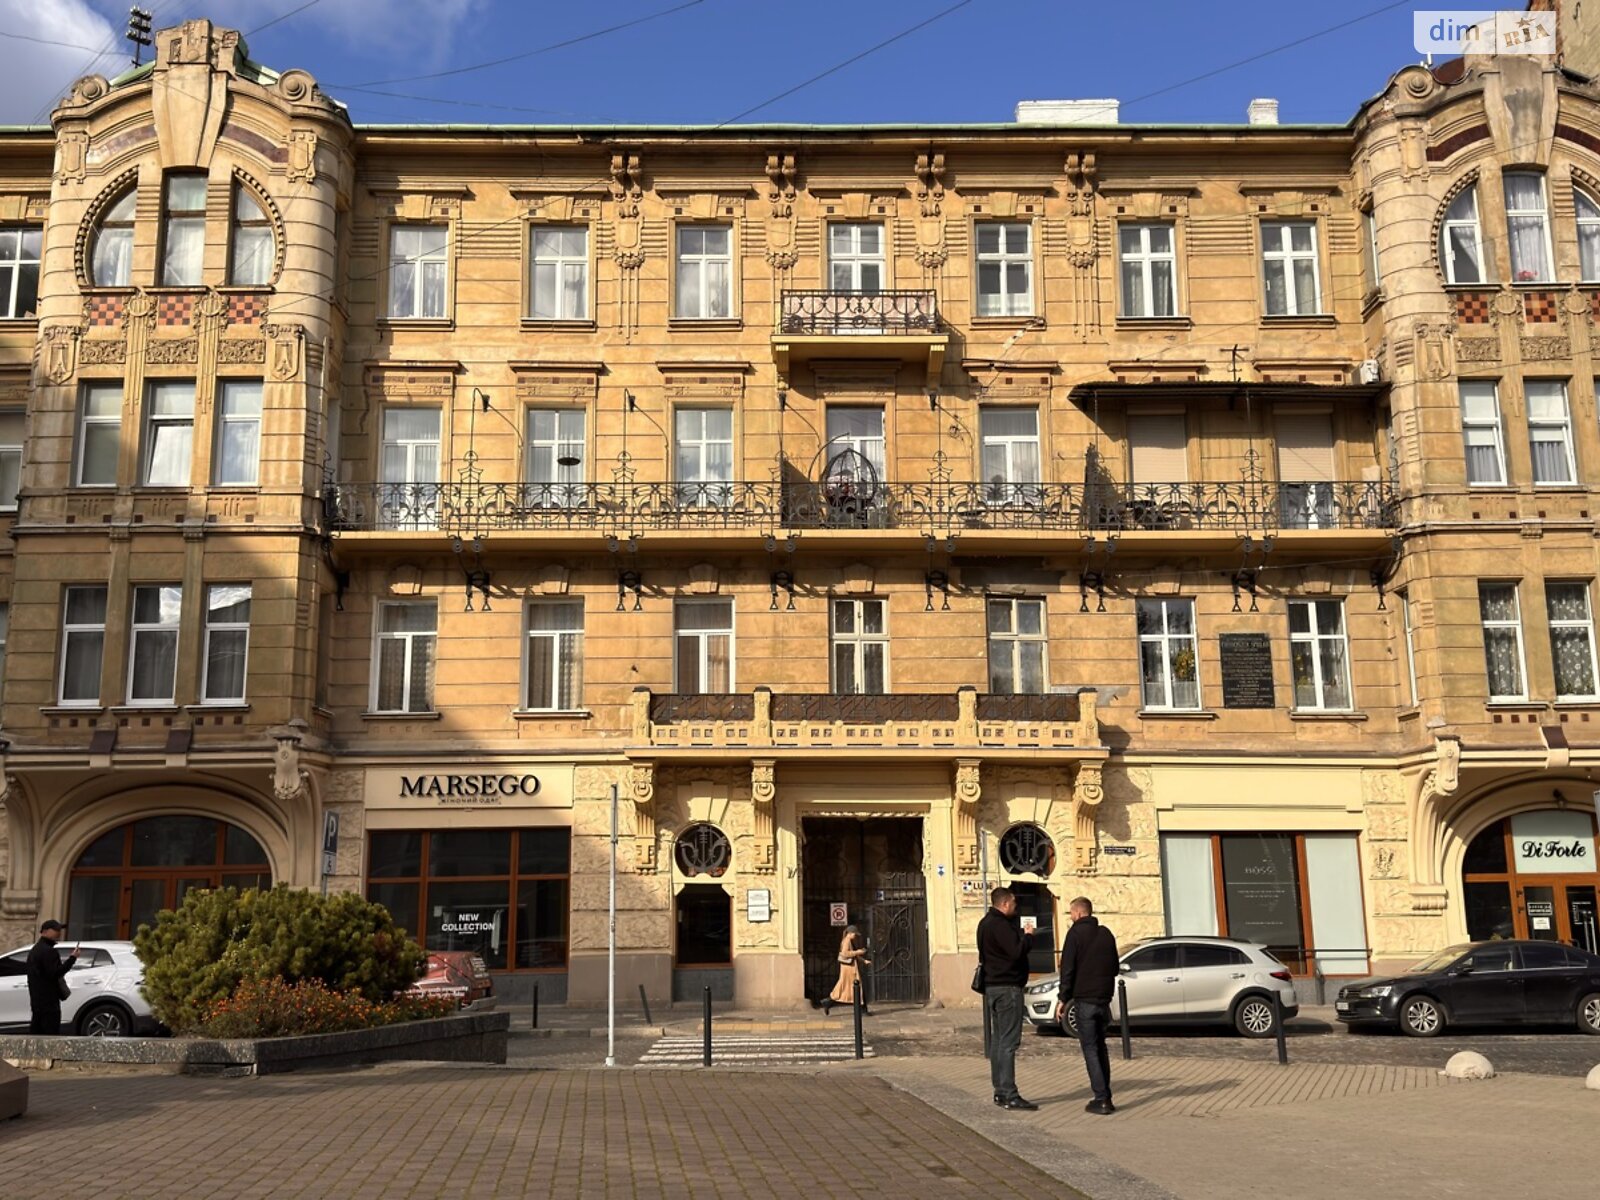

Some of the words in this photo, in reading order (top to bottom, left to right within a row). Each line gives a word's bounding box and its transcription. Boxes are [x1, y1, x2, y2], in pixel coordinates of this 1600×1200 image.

[400, 775, 540, 797] MARSEGO
[1522, 841, 1543, 857] Di
[1544, 841, 1586, 857] Forte
[458, 913, 479, 921] NEW
[441, 922, 495, 931] COLLECTION
